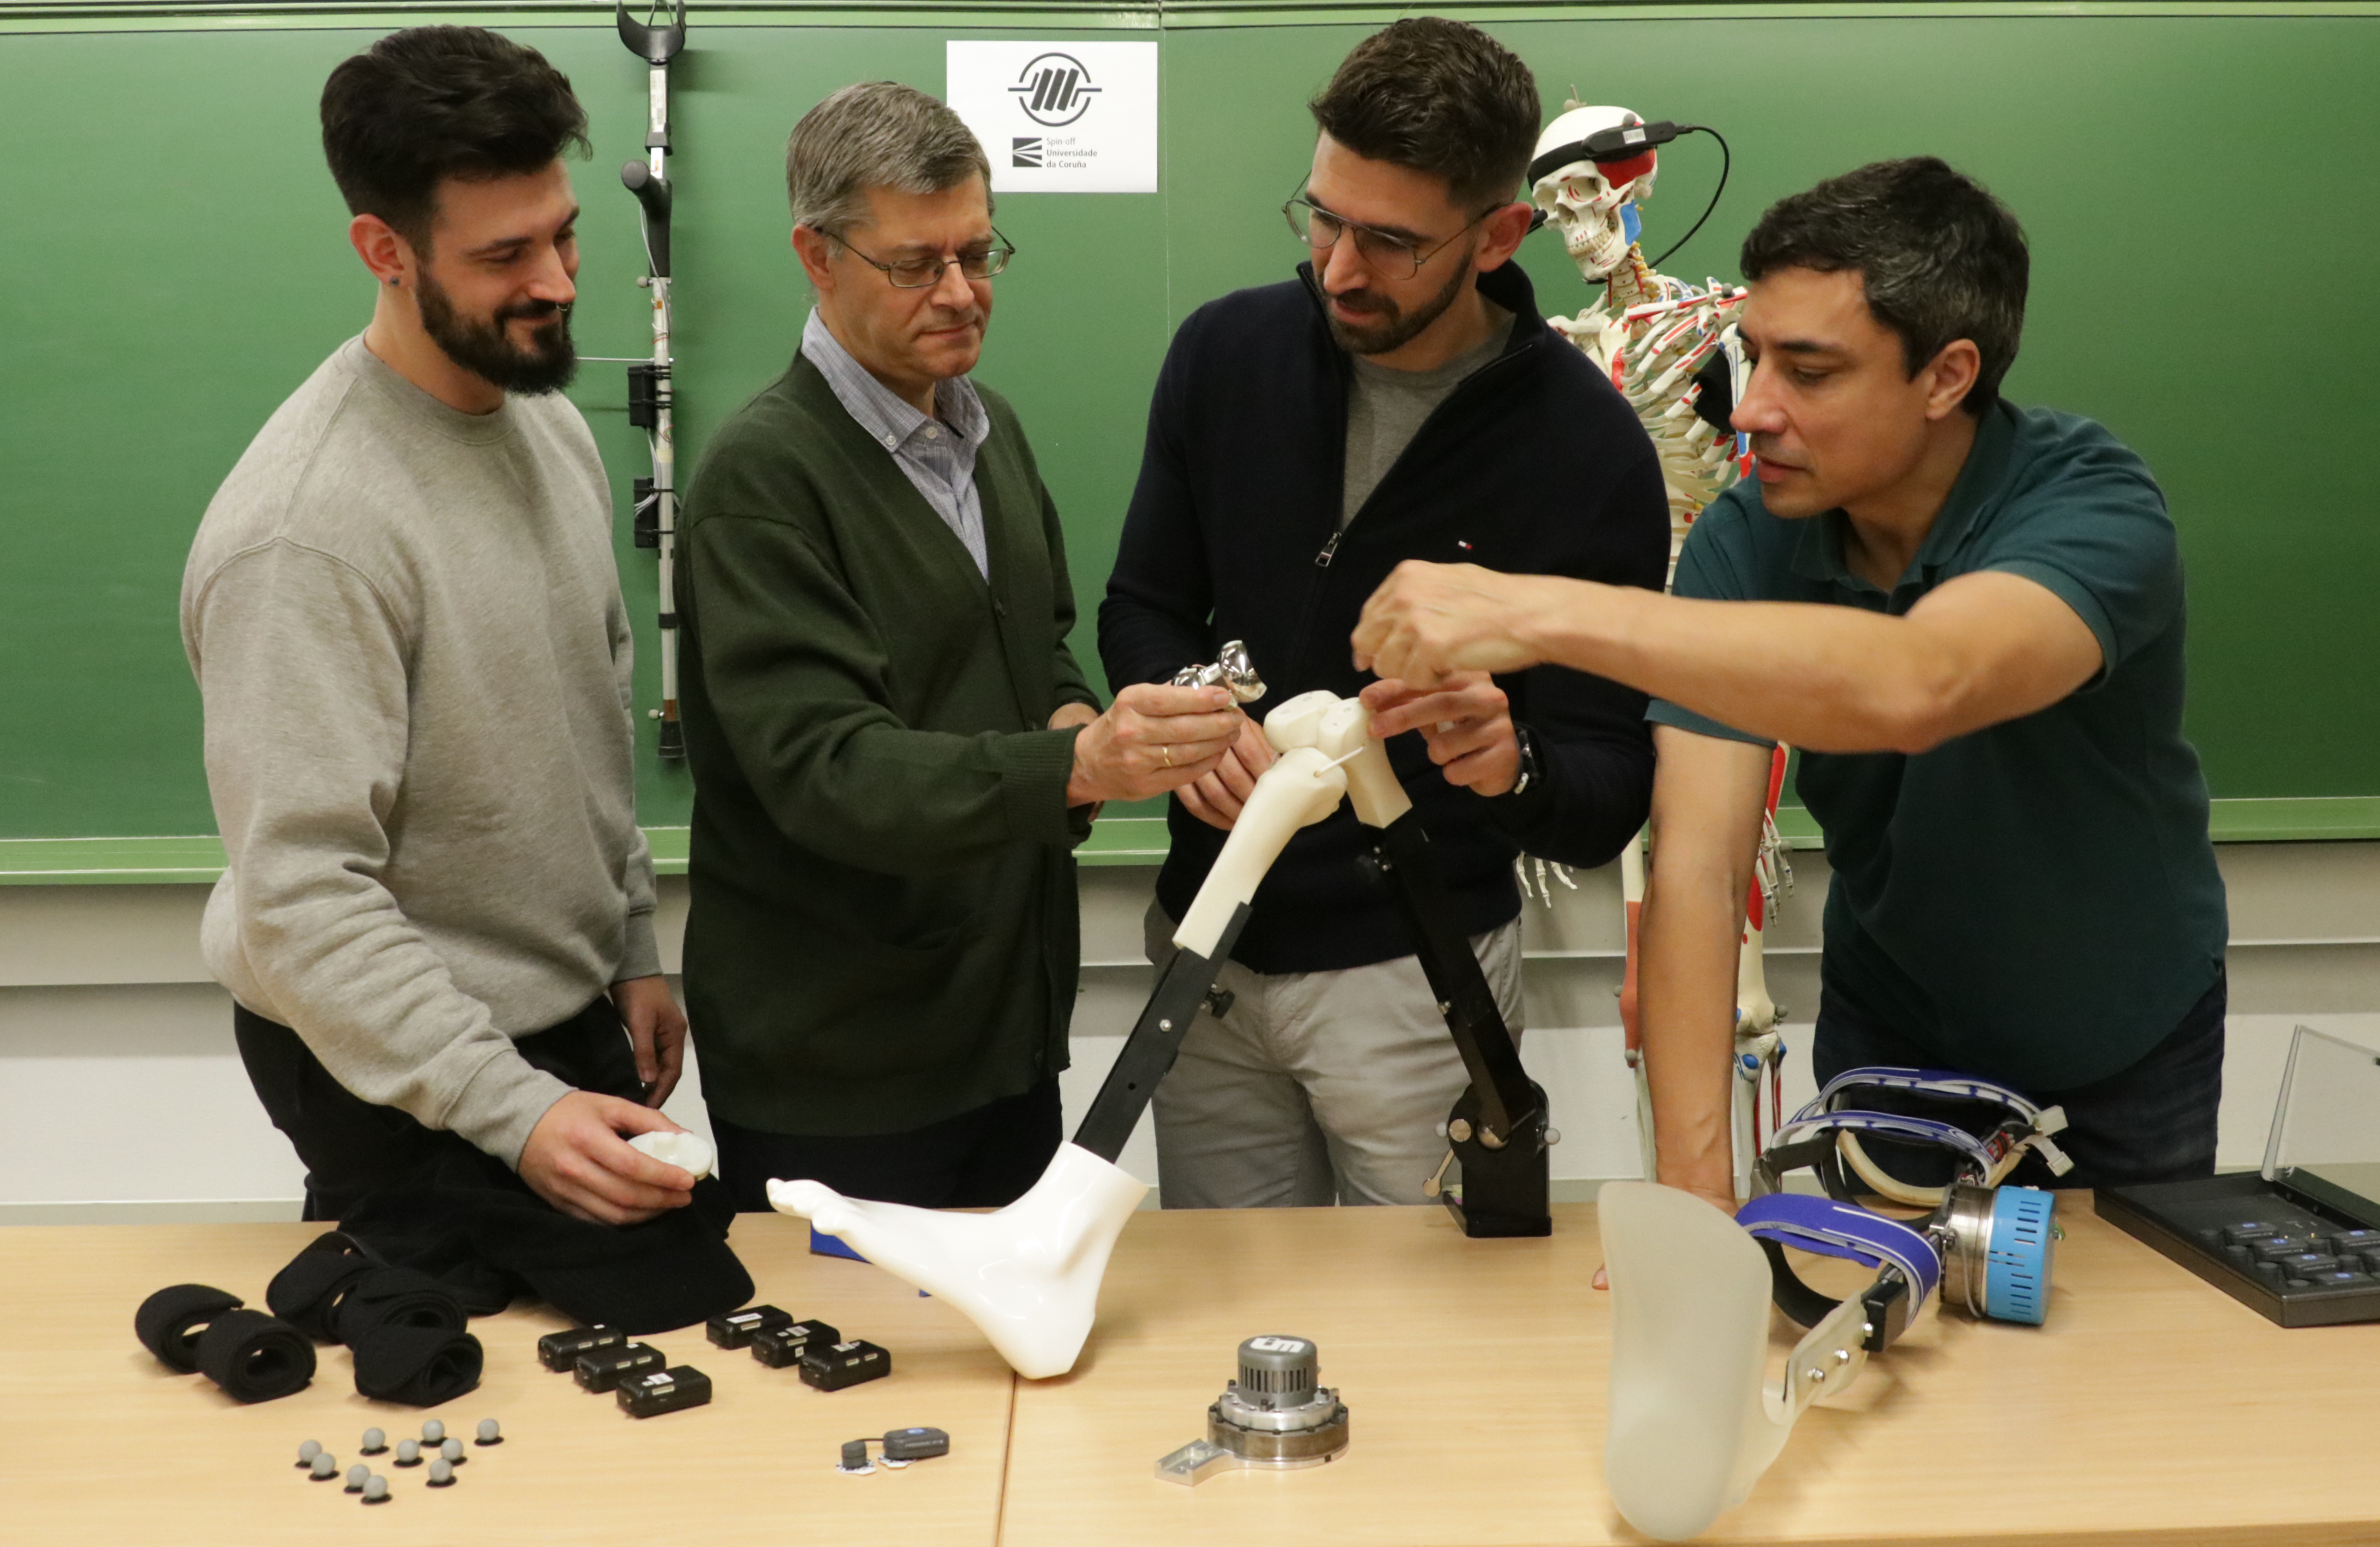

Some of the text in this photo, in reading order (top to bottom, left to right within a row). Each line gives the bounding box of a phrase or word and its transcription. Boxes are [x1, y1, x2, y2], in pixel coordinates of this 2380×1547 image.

[1047, 137, 1075, 147] Spin-off
[1047, 148, 1098, 157] Universidade
[1047, 159, 1056, 168] da
